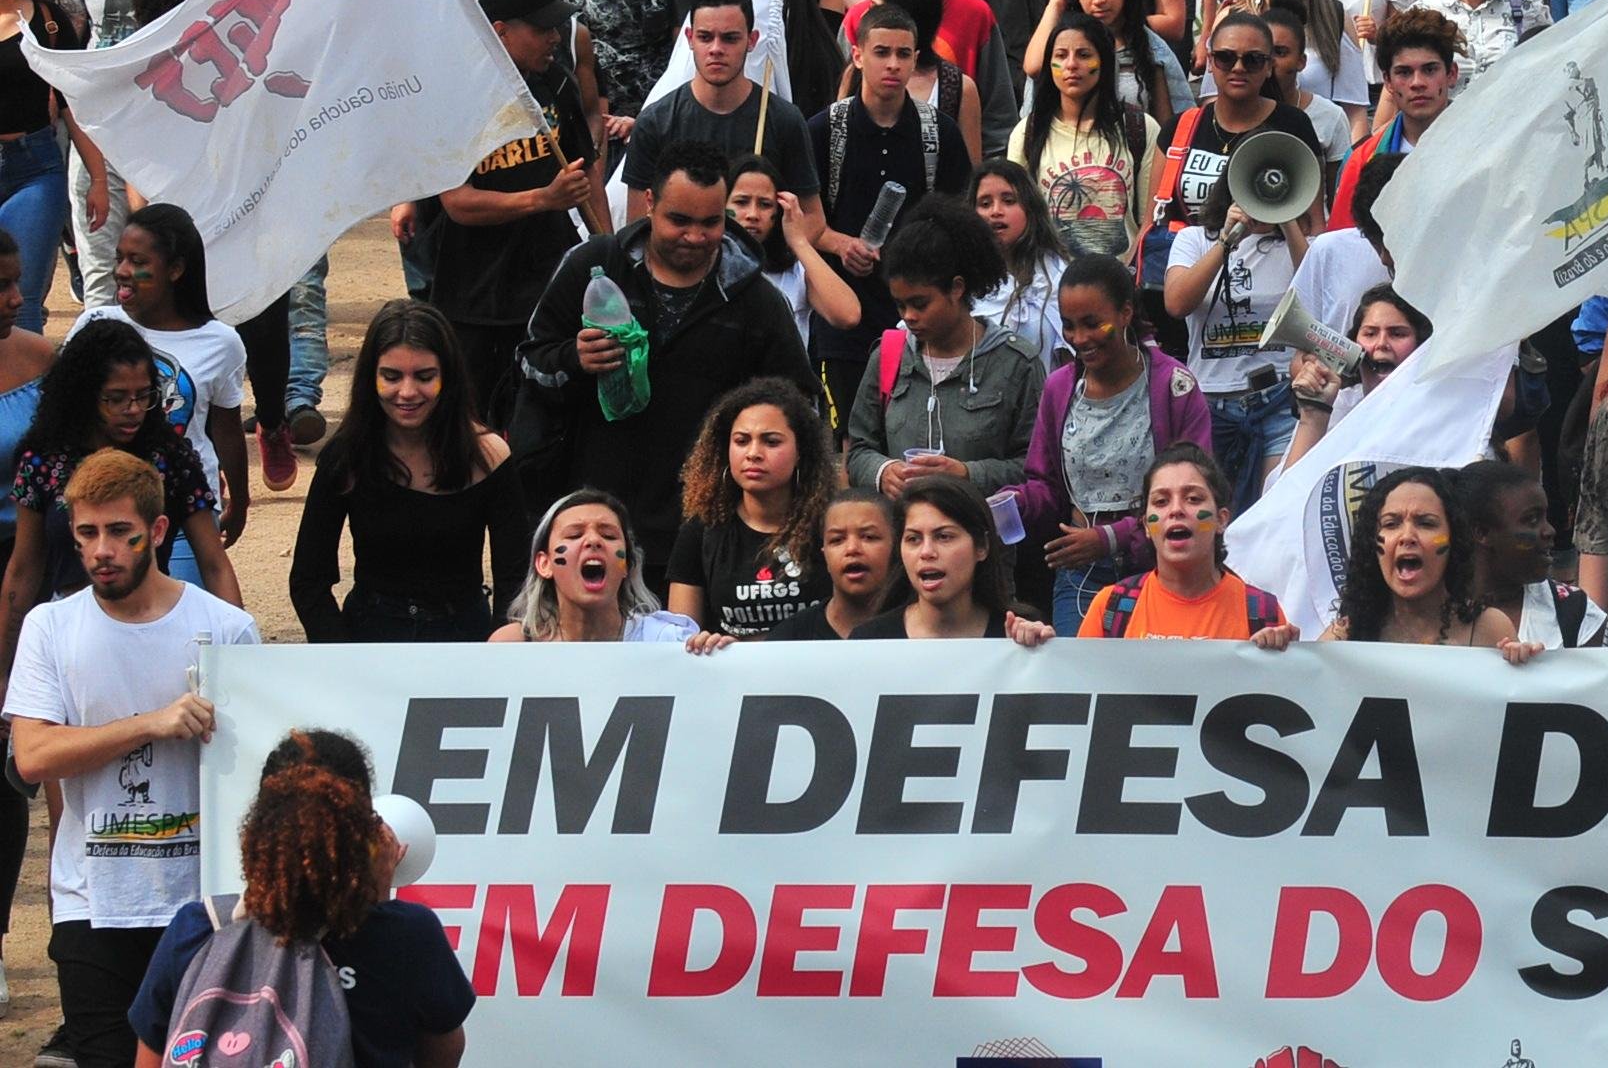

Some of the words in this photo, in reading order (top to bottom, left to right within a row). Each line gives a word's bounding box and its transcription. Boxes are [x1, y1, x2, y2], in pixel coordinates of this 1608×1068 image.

[1041, 152, 1093, 190] BEACH
[1190, 154, 1211, 171] EU
[1206, 320, 1267, 342] UMES
[736, 582, 801, 600] UFRGS
[390, 696, 675, 835] EM
[719, 693, 1430, 839] DEFESA
[91, 812, 193, 836] UMESPA
[396, 885, 611, 997] EM
[647, 883, 1219, 1000] DEFESA
[1265, 884, 1482, 1002] DO
